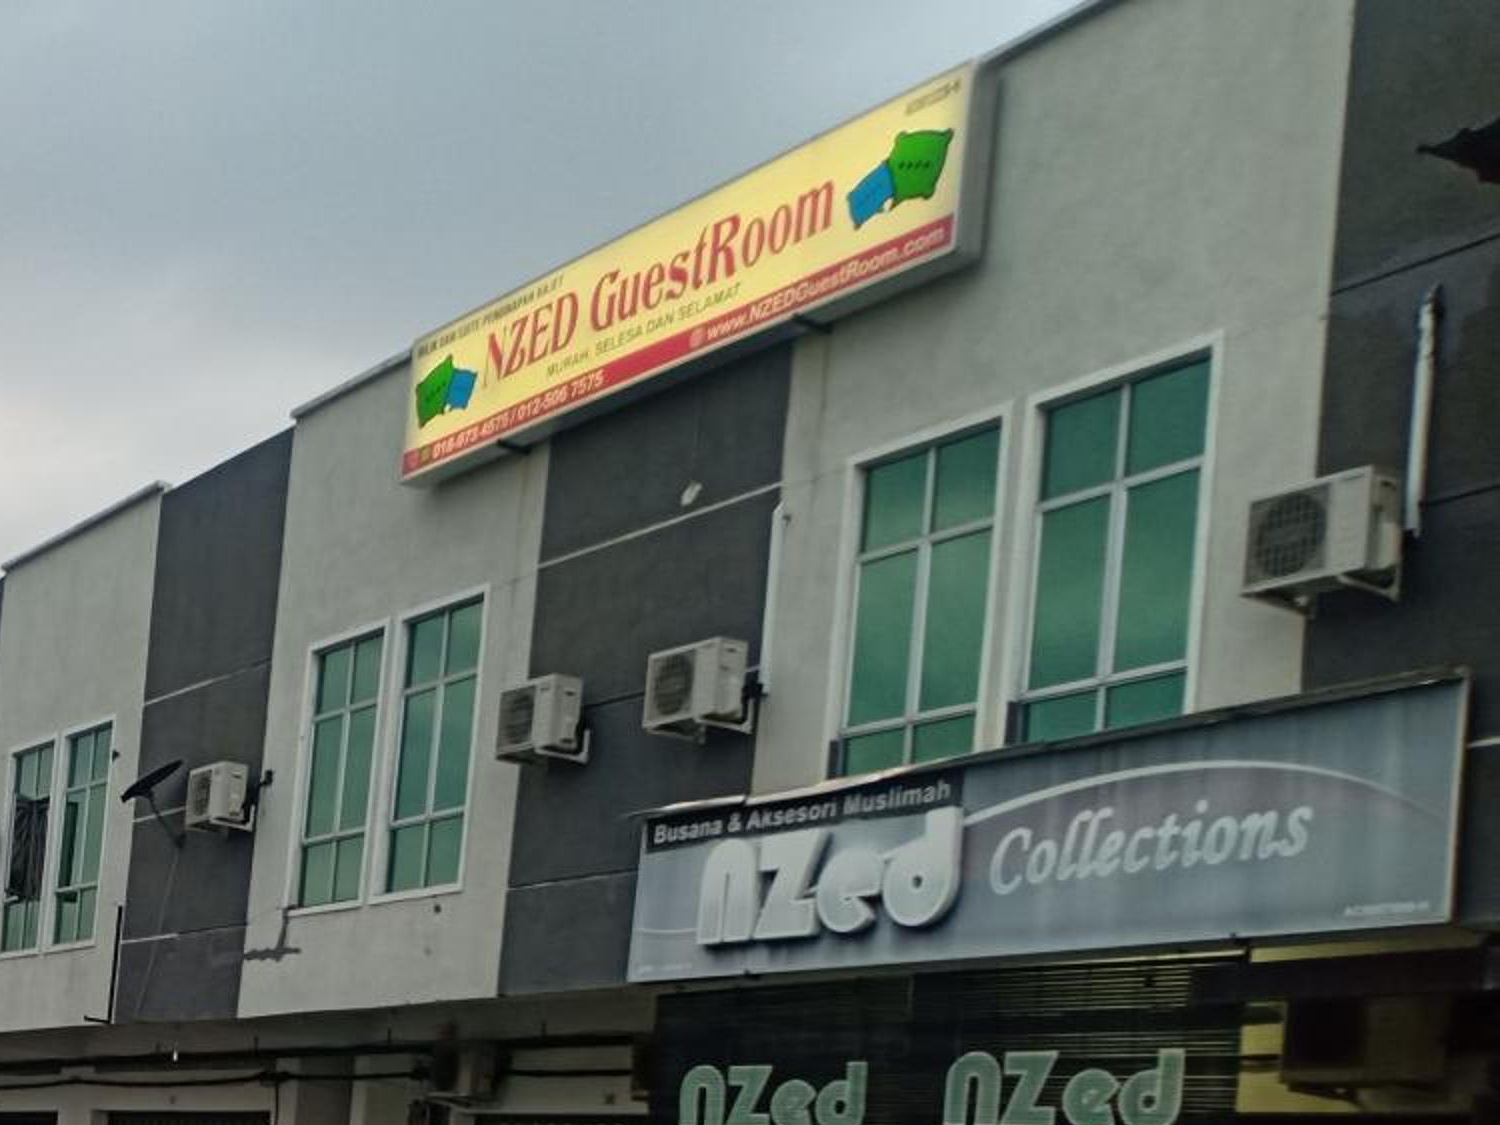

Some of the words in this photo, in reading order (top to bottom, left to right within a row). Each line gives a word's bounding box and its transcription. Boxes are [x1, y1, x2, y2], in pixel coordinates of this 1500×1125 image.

[482, 291, 579, 389] NZED
[590, 179, 835, 332] GuestRoom
[595, 326, 644, 352] SELESA
[646, 312, 676, 331] DAN
[678, 282, 741, 321] SELAMAT
[653, 819, 724, 845] Busana
[727, 812, 742, 833] &
[746, 801, 837, 831] Aksesori
[844, 780, 951, 816] Muslimah
[989, 799, 1313, 895] Collections
